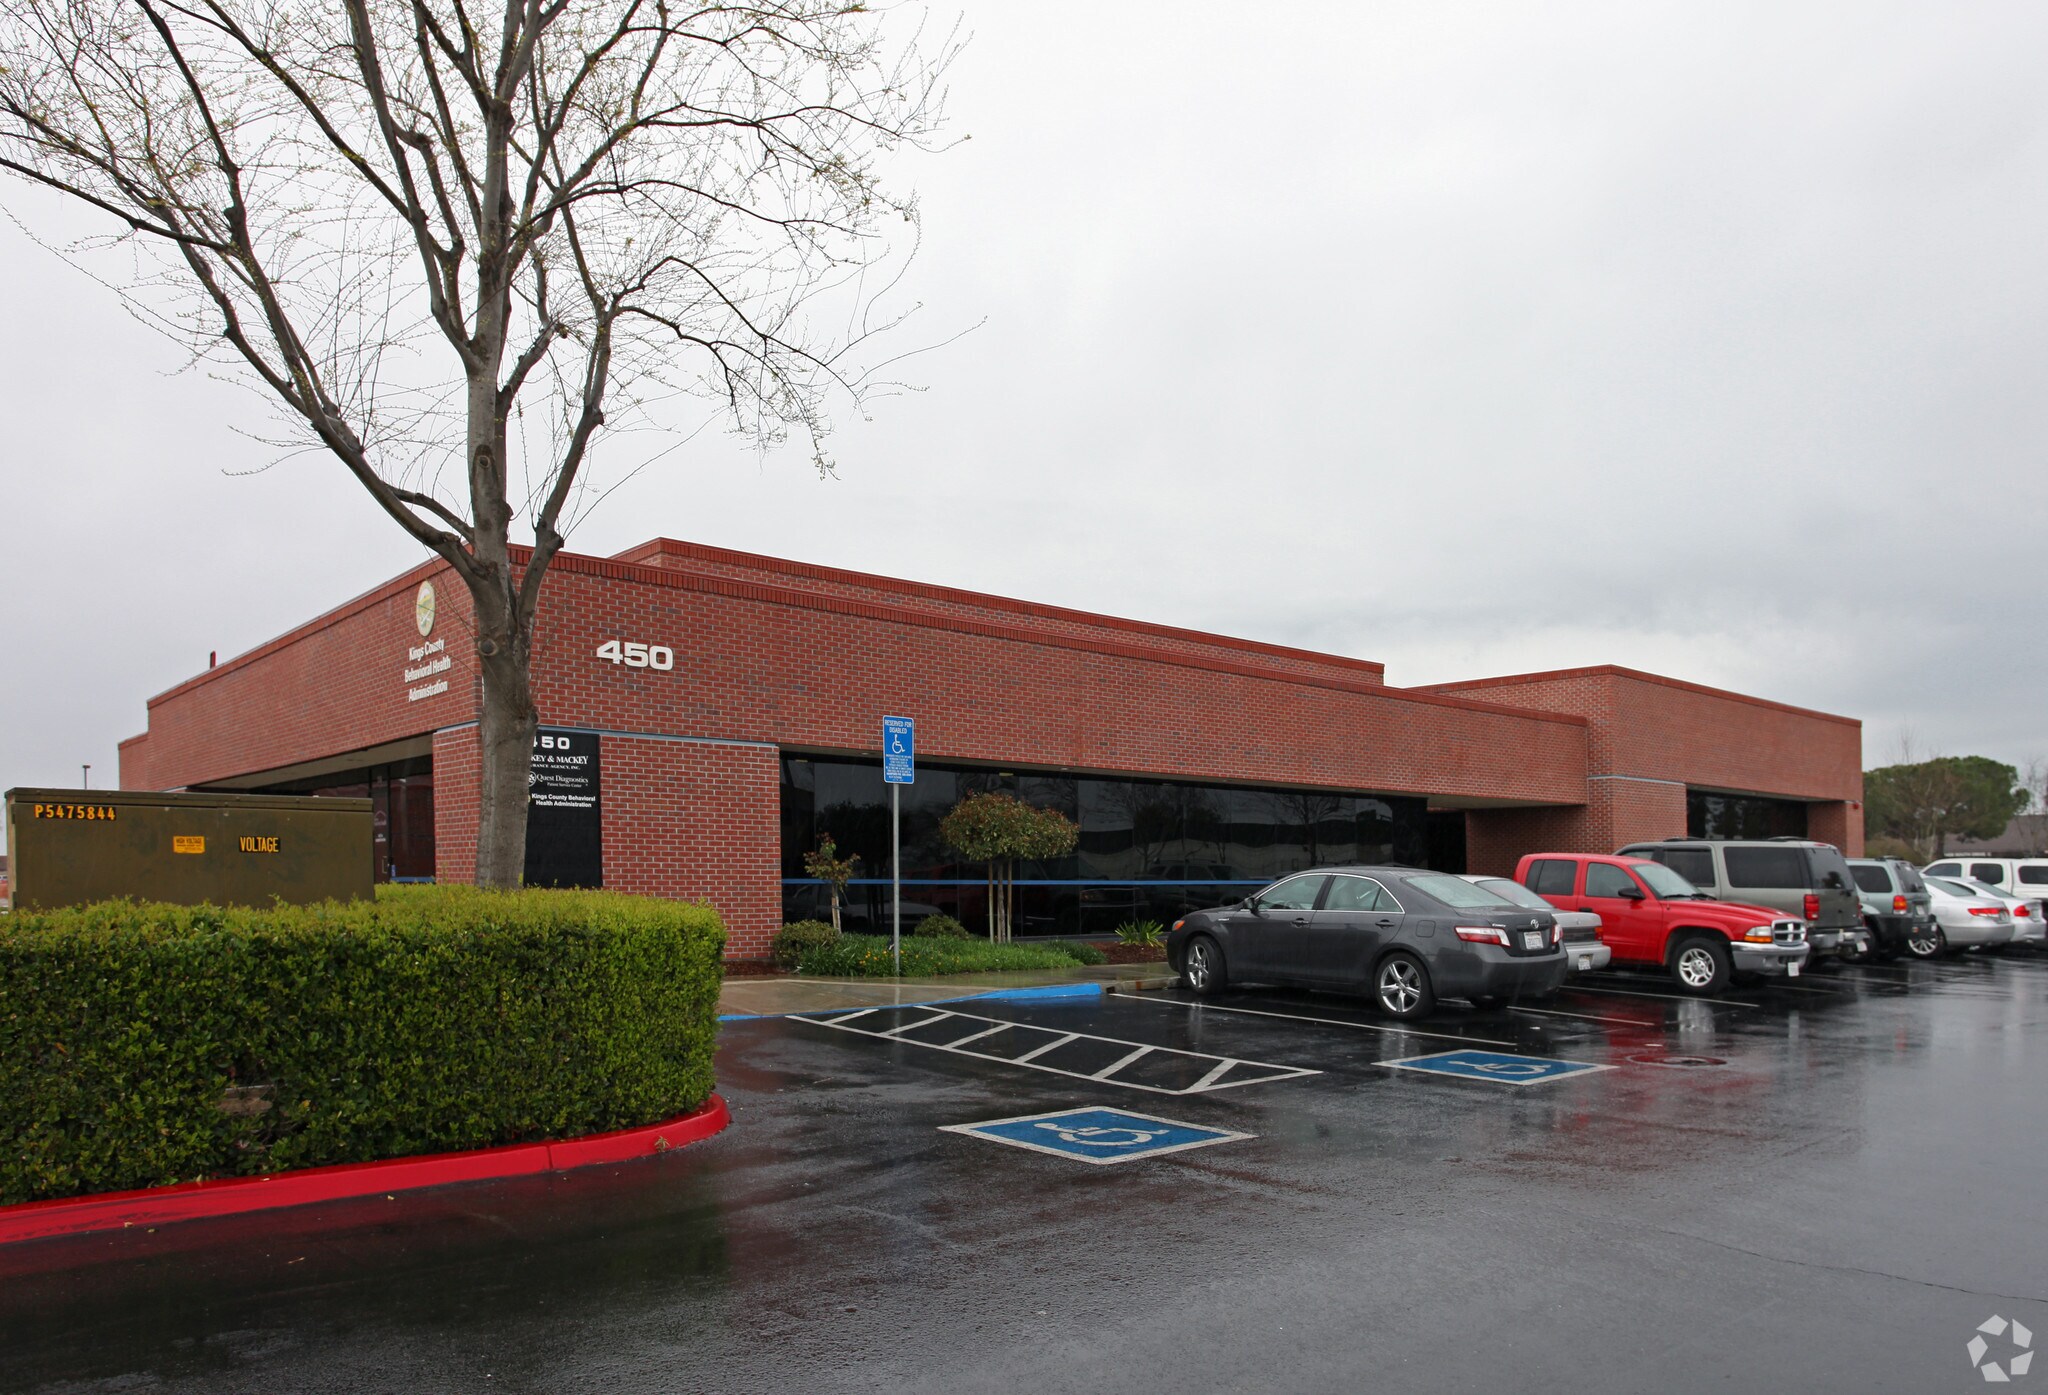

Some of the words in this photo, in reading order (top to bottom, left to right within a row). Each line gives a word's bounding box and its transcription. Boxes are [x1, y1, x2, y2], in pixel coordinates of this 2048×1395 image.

[409, 646, 425, 661] Kings
[424, 638, 445, 656] County
[596, 640, 674, 671] 450
[404, 661, 433, 683] Behavioral
[432, 655, 451, 675] Health
[408, 679, 448, 702] Administration
[884, 719, 904, 727] RESERVED
[889, 727, 908, 735] DISABLED
[531, 754, 547, 763] KEY
[547, 755, 555, 763] &
[556, 755, 589, 765] MACKEY
[536, 773, 555, 783] Quest
[555, 774, 589, 784] Diagnostics
[531, 793, 548, 801] Kings
[548, 794, 568, 802] County
[568, 794, 596, 802] Behavioral
[554, 800, 592, 808] Administration
[34, 804, 116, 820] P5475844
[240, 836, 279, 853] VOLTAGE
